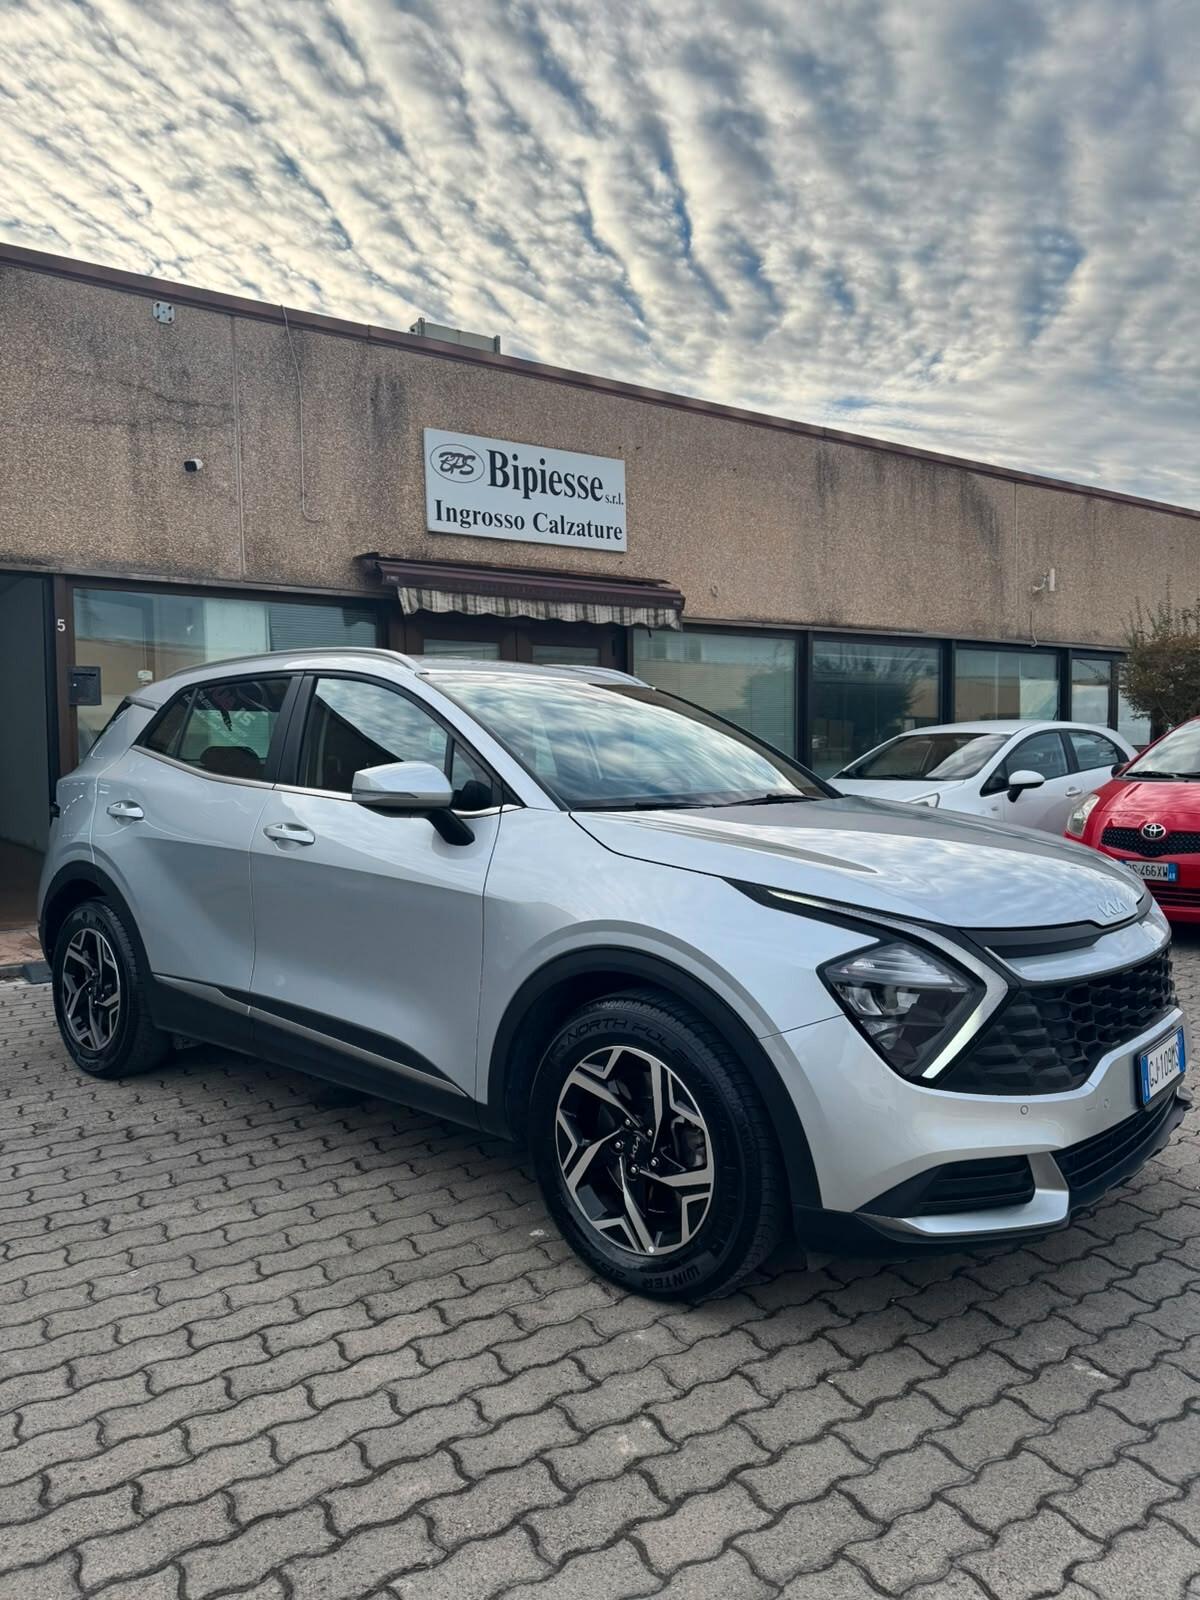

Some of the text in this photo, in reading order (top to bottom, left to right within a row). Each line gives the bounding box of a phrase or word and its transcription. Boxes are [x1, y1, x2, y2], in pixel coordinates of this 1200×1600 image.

[486, 448, 625, 506] Bipiesse s.r.l.
[434, 499, 623, 541] Ingrosso Calzature
[57, 618, 66, 632] 5
[566, 1017, 628, 1044] NORTH
[642, 1265, 701, 1289] WINTER
